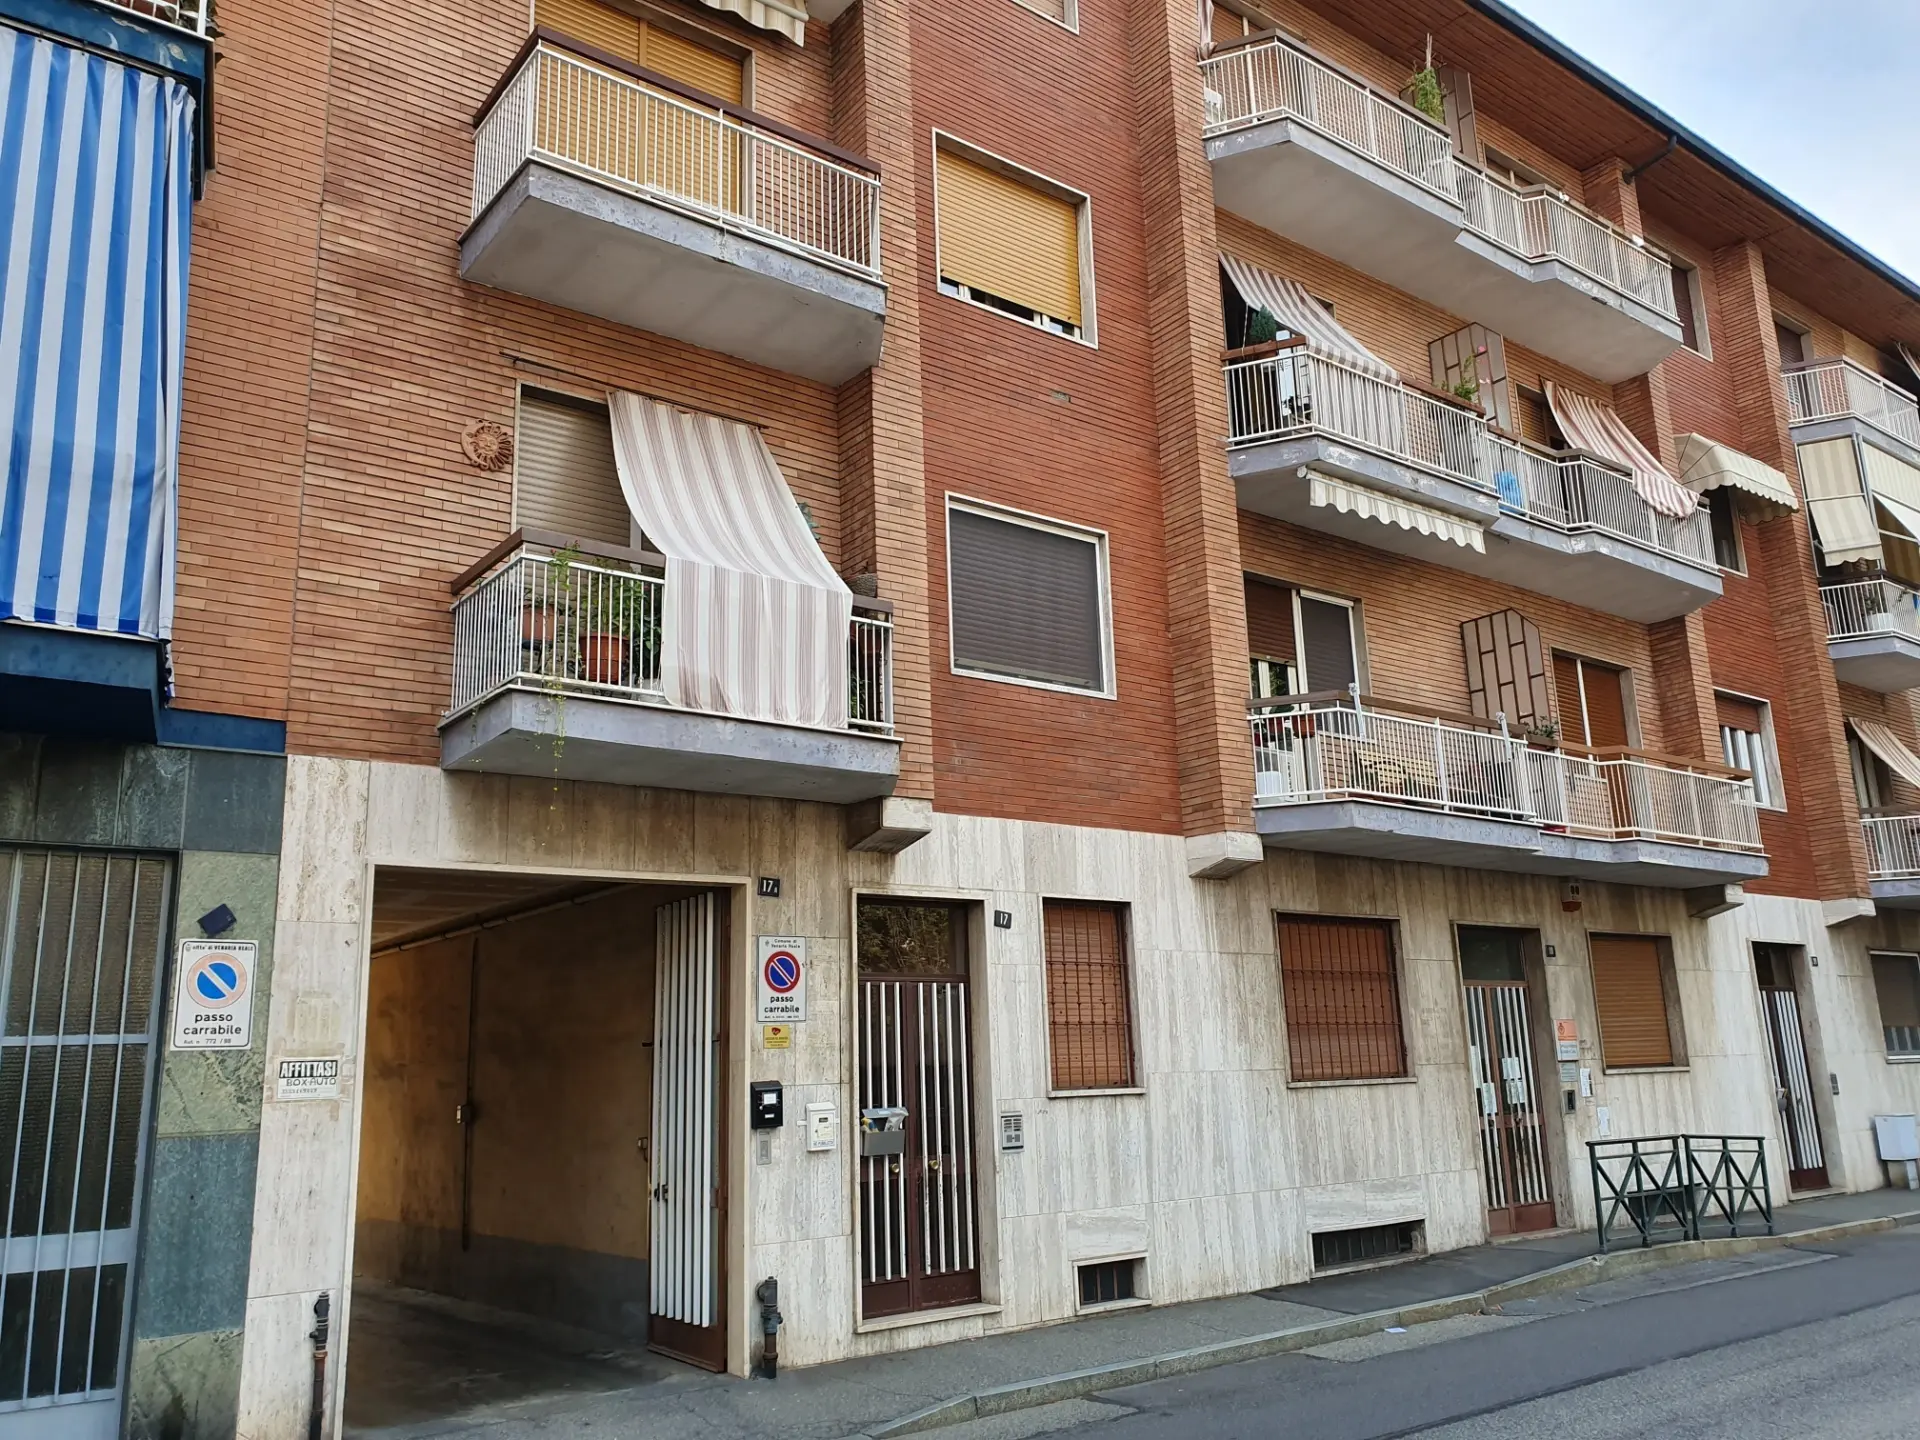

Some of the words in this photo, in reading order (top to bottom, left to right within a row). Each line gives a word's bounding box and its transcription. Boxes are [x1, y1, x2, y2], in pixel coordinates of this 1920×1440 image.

[1000, 912, 1009, 926] 17
[764, 1005, 800, 1013] carrabile
[194, 1013, 233, 1024] passo
[183, 1025, 242, 1035] carrabile
[280, 1061, 337, 1077] AFFITTASI
